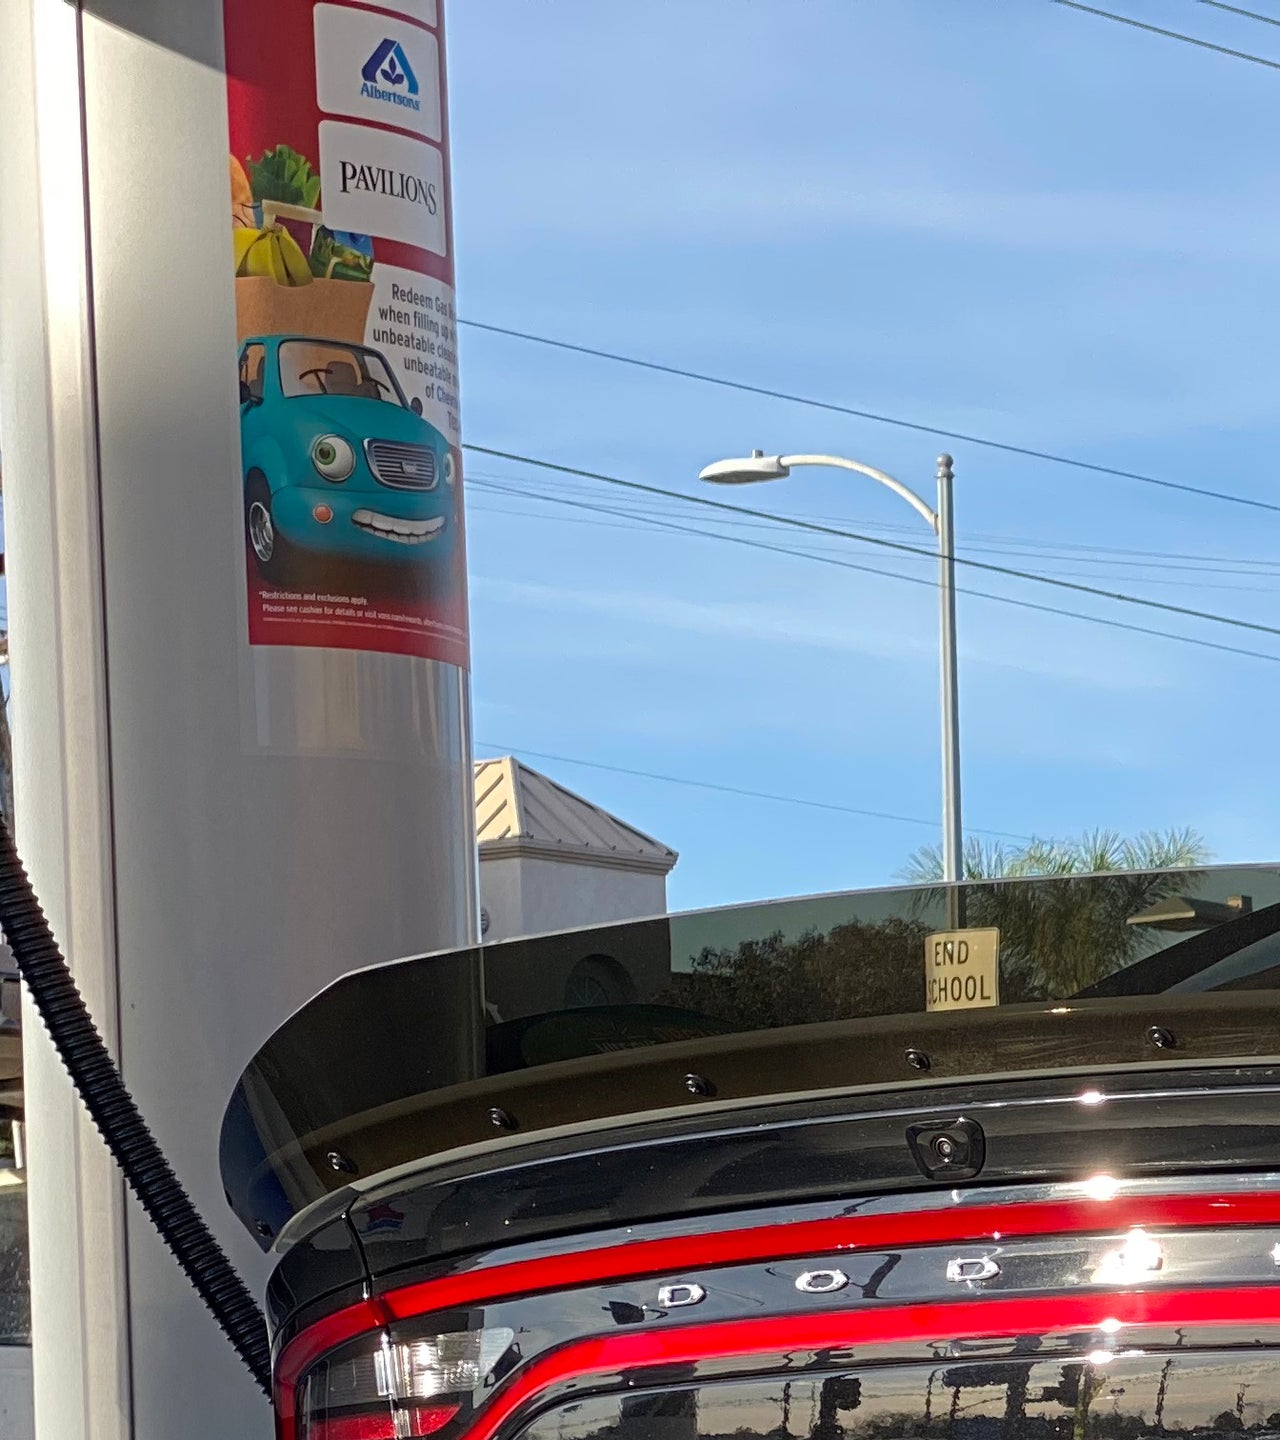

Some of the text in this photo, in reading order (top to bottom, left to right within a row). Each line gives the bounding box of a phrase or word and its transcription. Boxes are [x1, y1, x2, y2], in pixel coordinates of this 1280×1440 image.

[360, 82, 421, 111] Albertsons
[339, 160, 437, 216] PAVILIONS
[391, 283, 433, 309] Redeem
[378, 305, 411, 326] when
[413, 311, 440, 338] filling
[373, 328, 436, 355] unbeatable
[404, 357, 451, 382] unbeatable
[425, 383, 434, 399] of
[262, 603, 285, 613] Please
[934, 940, 969, 967] END
